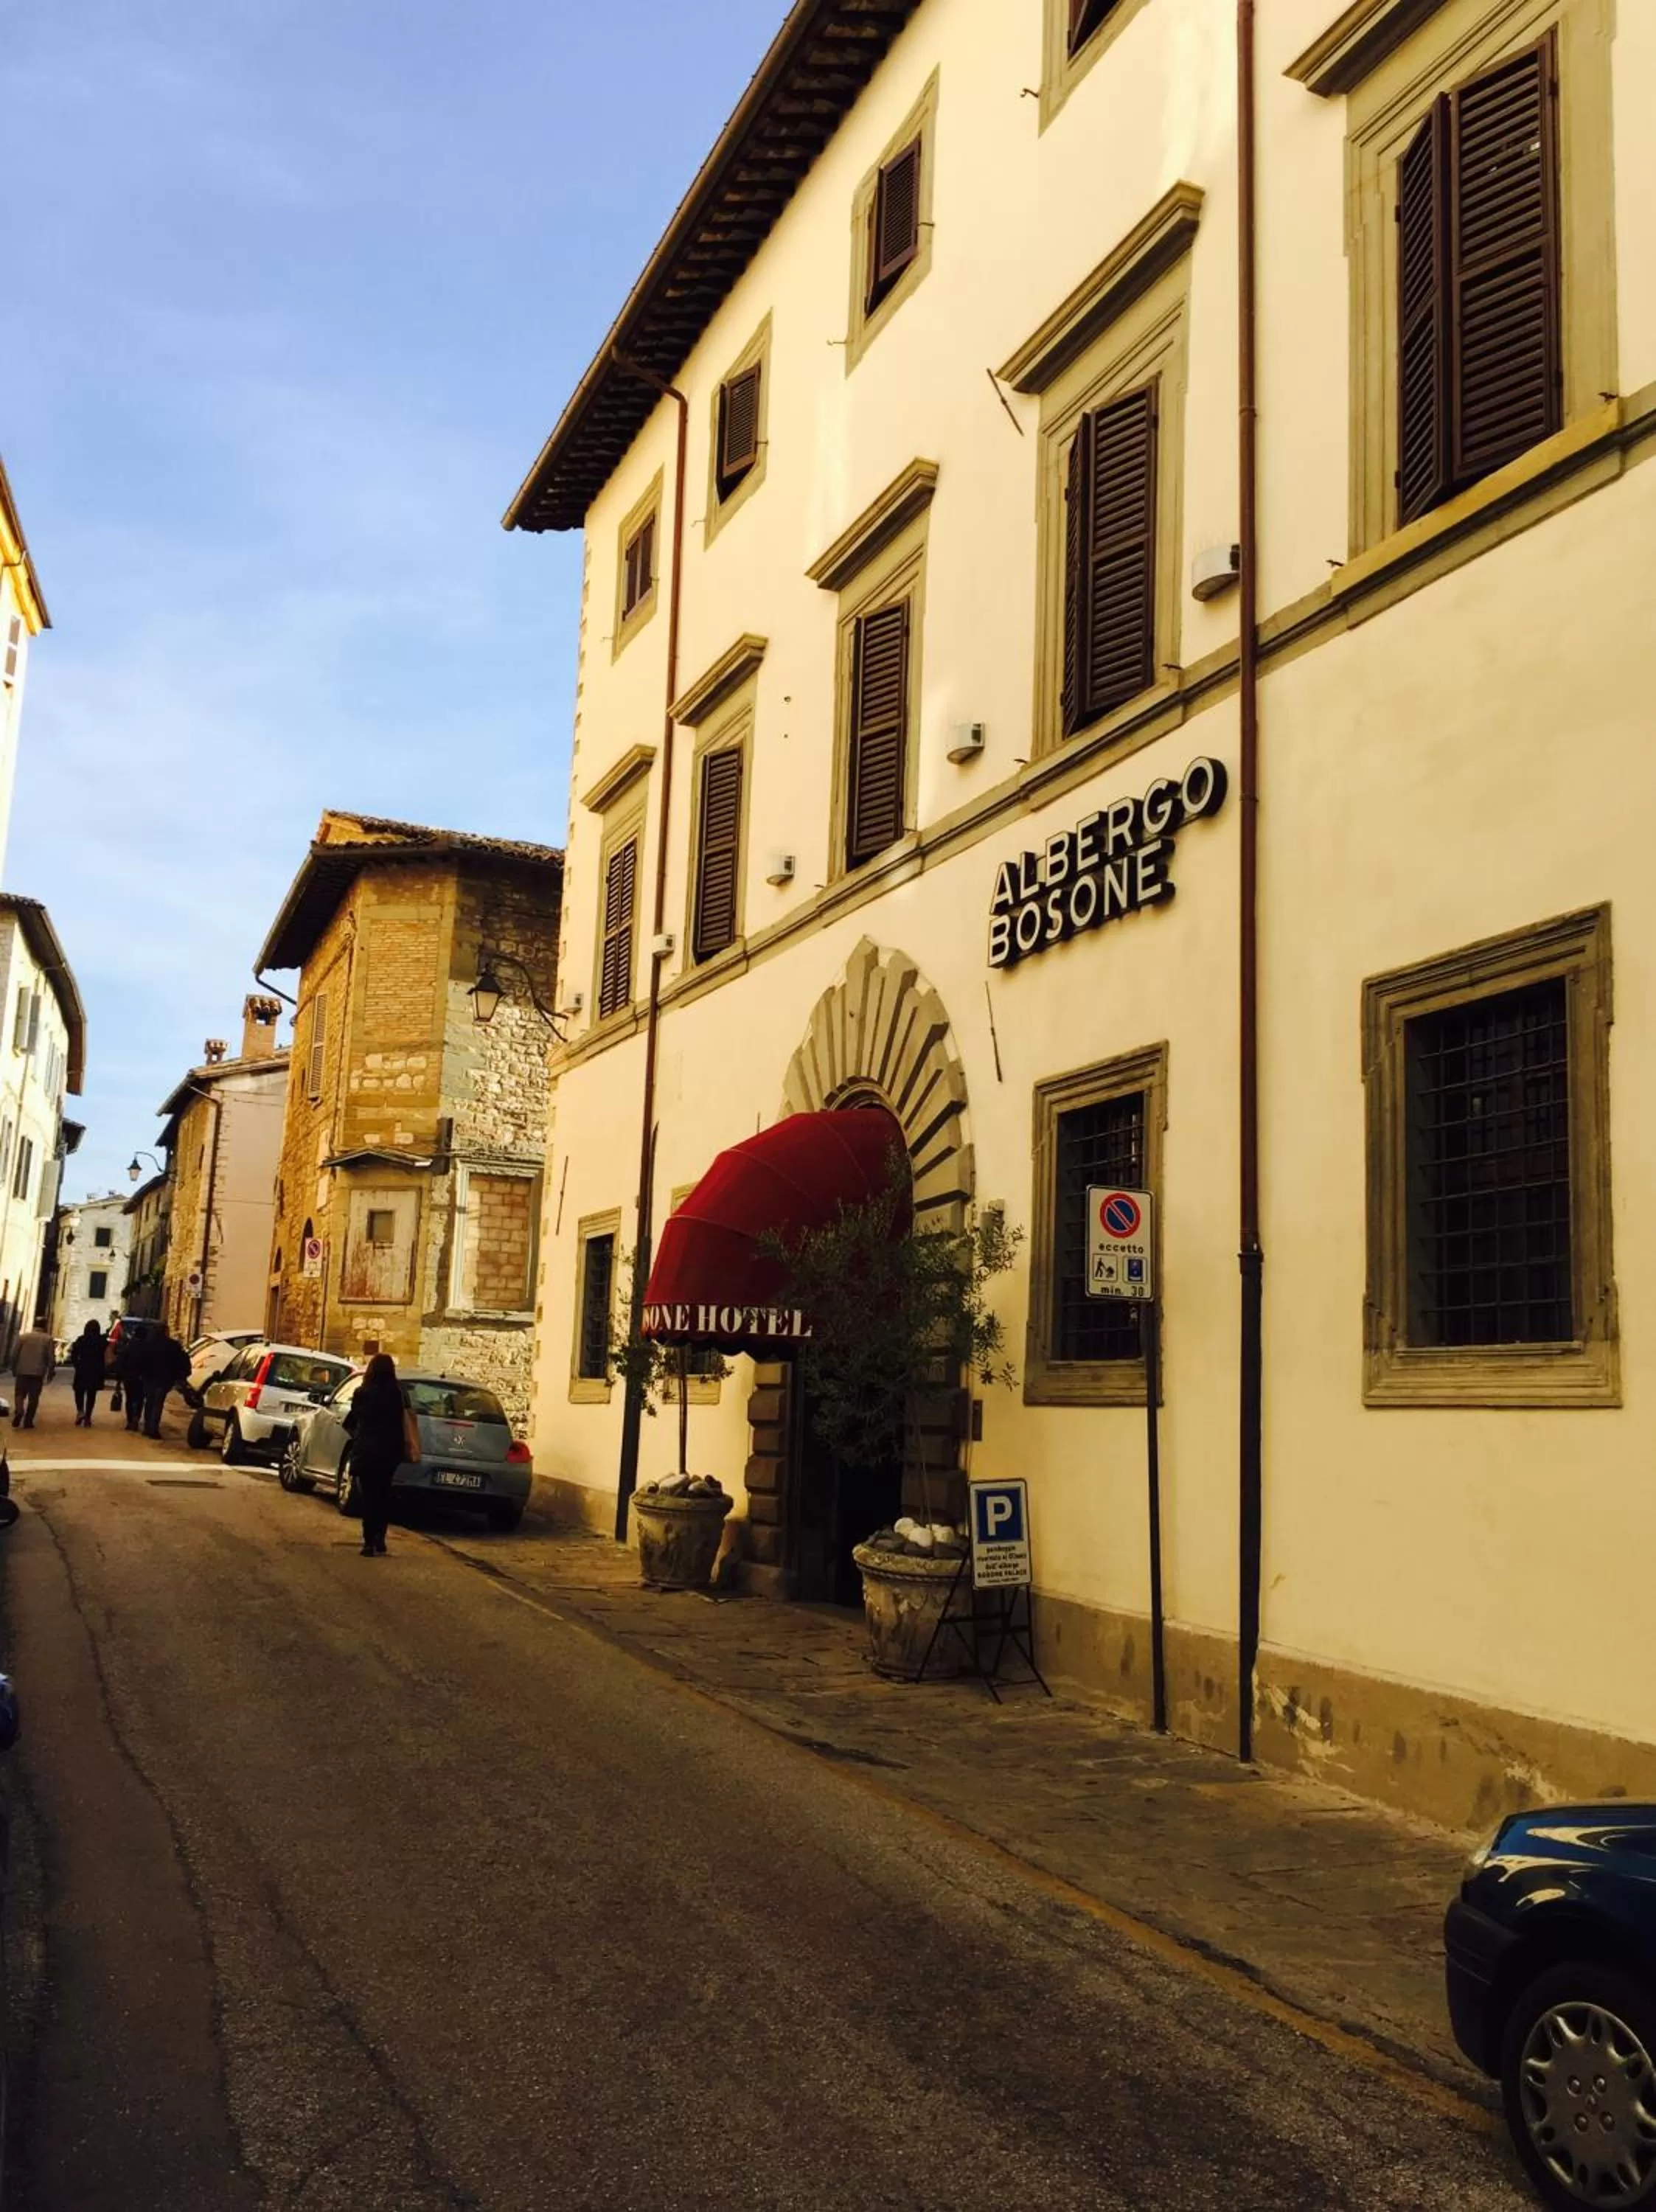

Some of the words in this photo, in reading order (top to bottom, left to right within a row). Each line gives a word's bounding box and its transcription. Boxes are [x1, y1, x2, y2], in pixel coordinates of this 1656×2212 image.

[989, 756, 1227, 914] ALBERGO
[988, 838, 1173, 968] BOSONE
[1098, 1242, 1144, 1253] eccetto
[697, 1304, 812, 1337] HOTEL
[986, 1495, 1012, 1537] P
